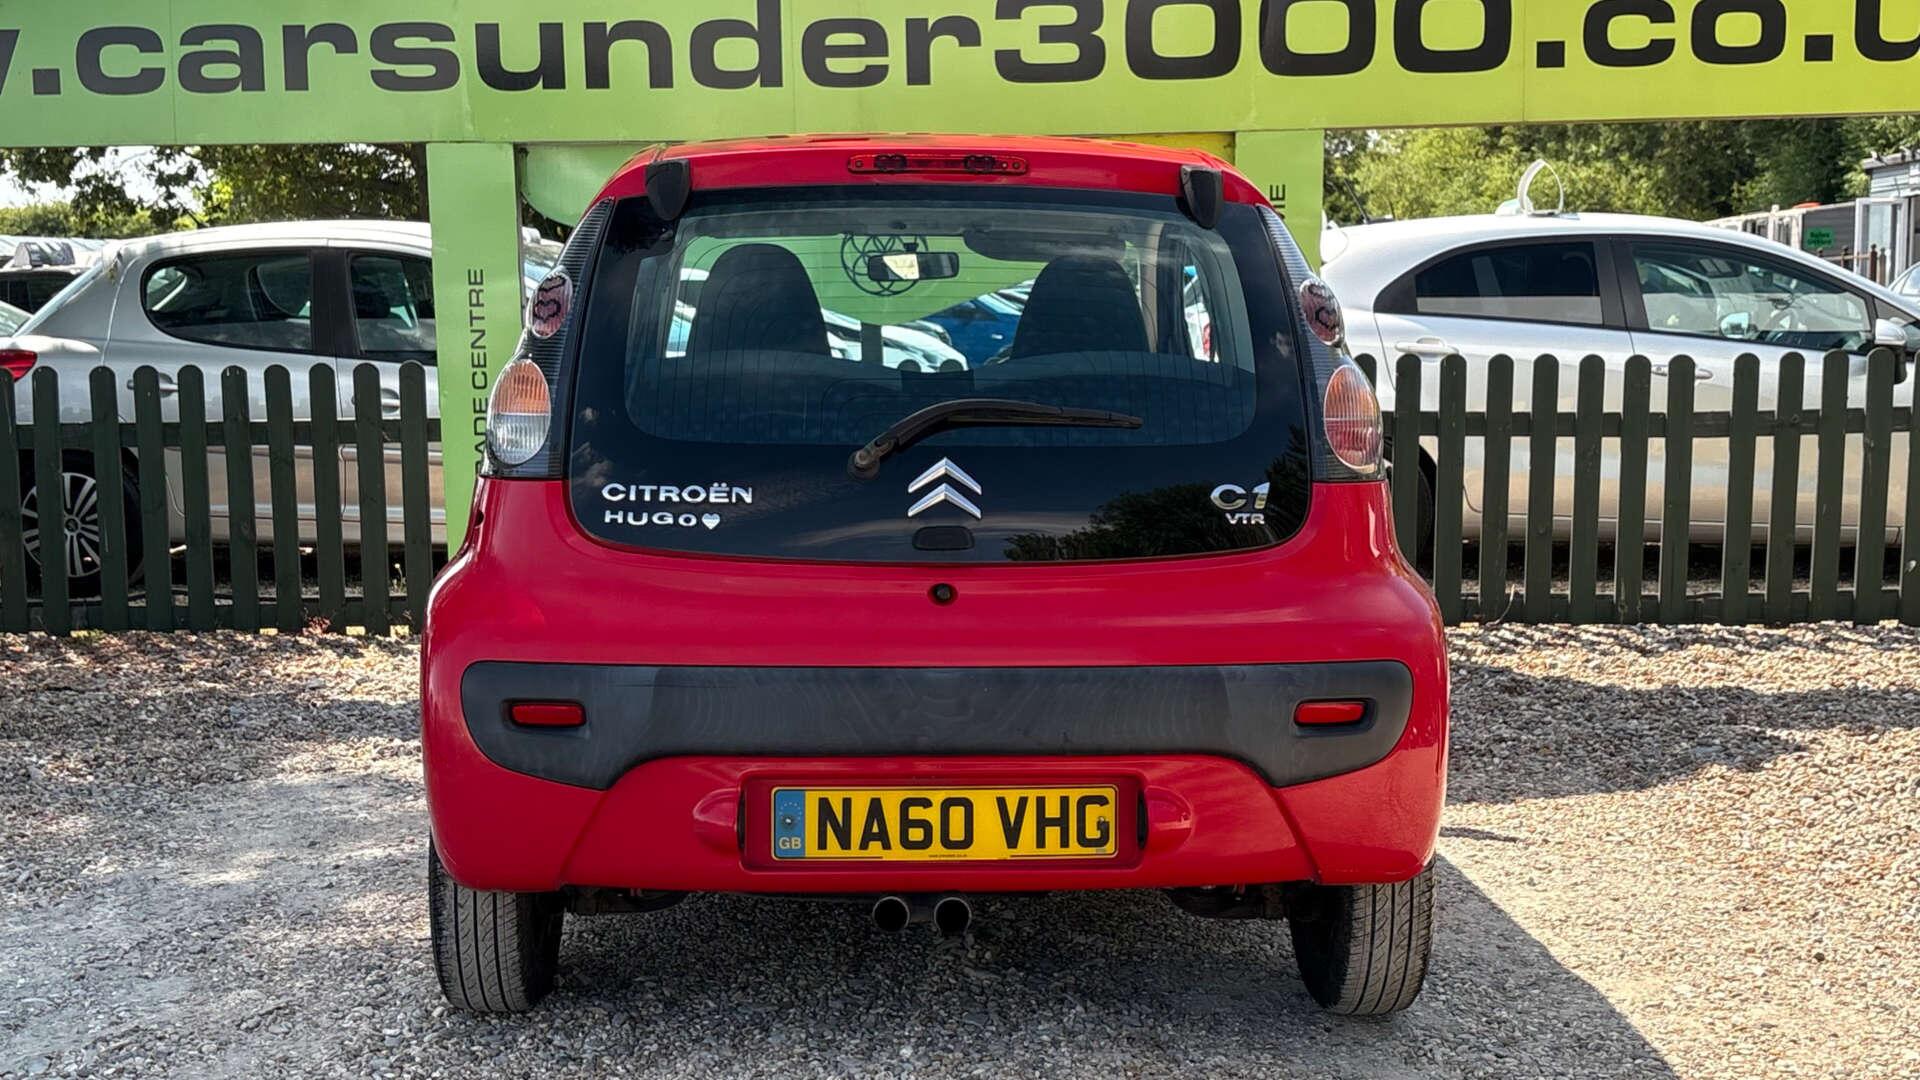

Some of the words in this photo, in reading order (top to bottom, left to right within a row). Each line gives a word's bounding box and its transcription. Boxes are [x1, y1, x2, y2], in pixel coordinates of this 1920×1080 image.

[468, 269, 487, 390] CENTRE
[601, 482, 753, 504] CITROËN
[1210, 482, 1270, 510] C1
[604, 510, 697, 527] HUGO
[1225, 512, 1265, 525] VTR
[817, 797, 974, 851] NA60
[996, 795, 1110, 849] VHG
[779, 836, 802, 850] GB
